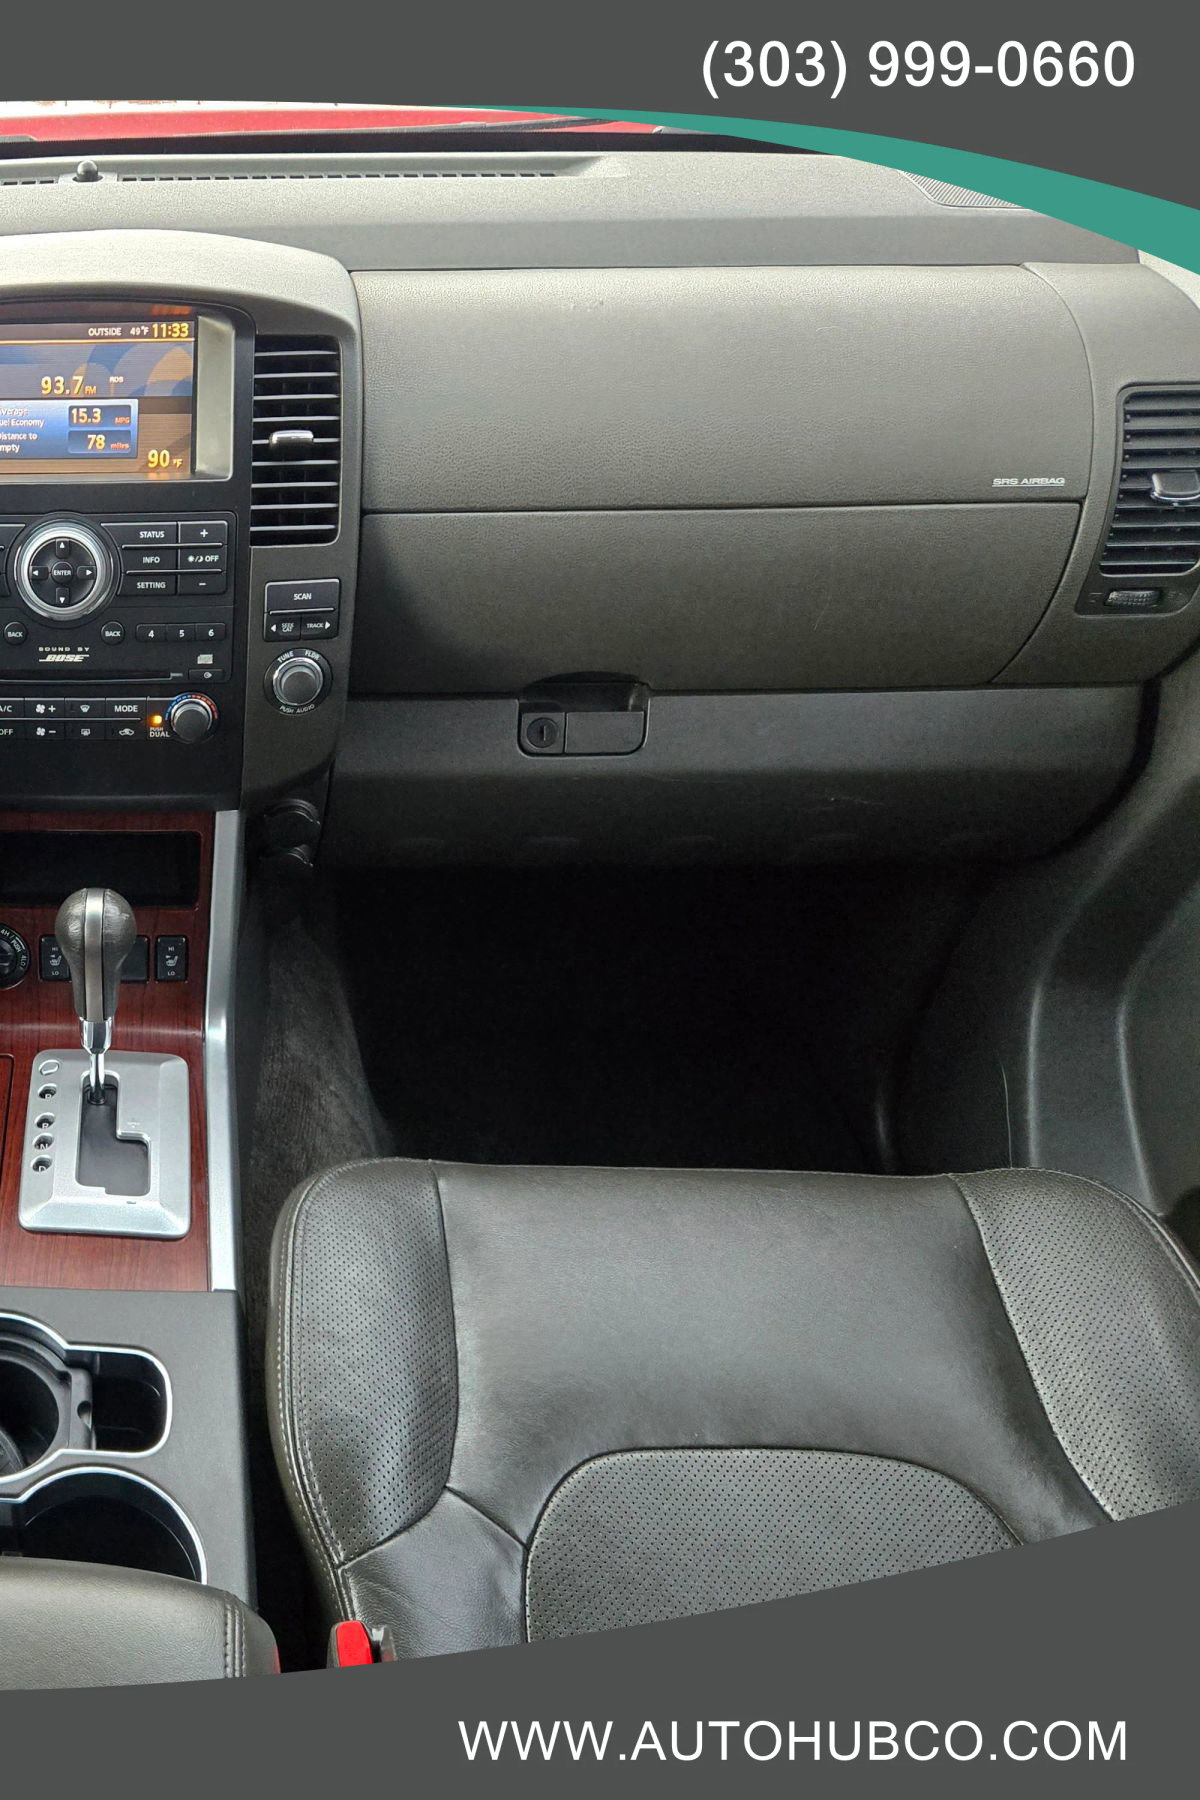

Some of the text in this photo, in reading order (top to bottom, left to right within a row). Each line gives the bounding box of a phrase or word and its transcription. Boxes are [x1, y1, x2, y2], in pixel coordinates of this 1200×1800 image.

[88, 327, 122, 336] OUTSIDE
[152, 323, 189, 338] 11:33
[41, 375, 84, 395] 93.7
[71, 408, 101, 424] 15.3
[11, 419, 45, 429] Economy
[29, 432, 38, 440] to
[87, 434, 106, 450] 78
[148, 449, 170, 468] 90
[992, 477, 1065, 486] SRS AIRBAG
[293, 592, 312, 601] SCAN
[148, 630, 155, 638] 4
[179, 629, 185, 637] 5
[208, 629, 214, 637] 6
[39, 654, 90, 662] BOSE
[277, 651, 294, 663] TUNE
[114, 705, 138, 713] MODE
[280, 703, 315, 714] PUSH AUDIO
